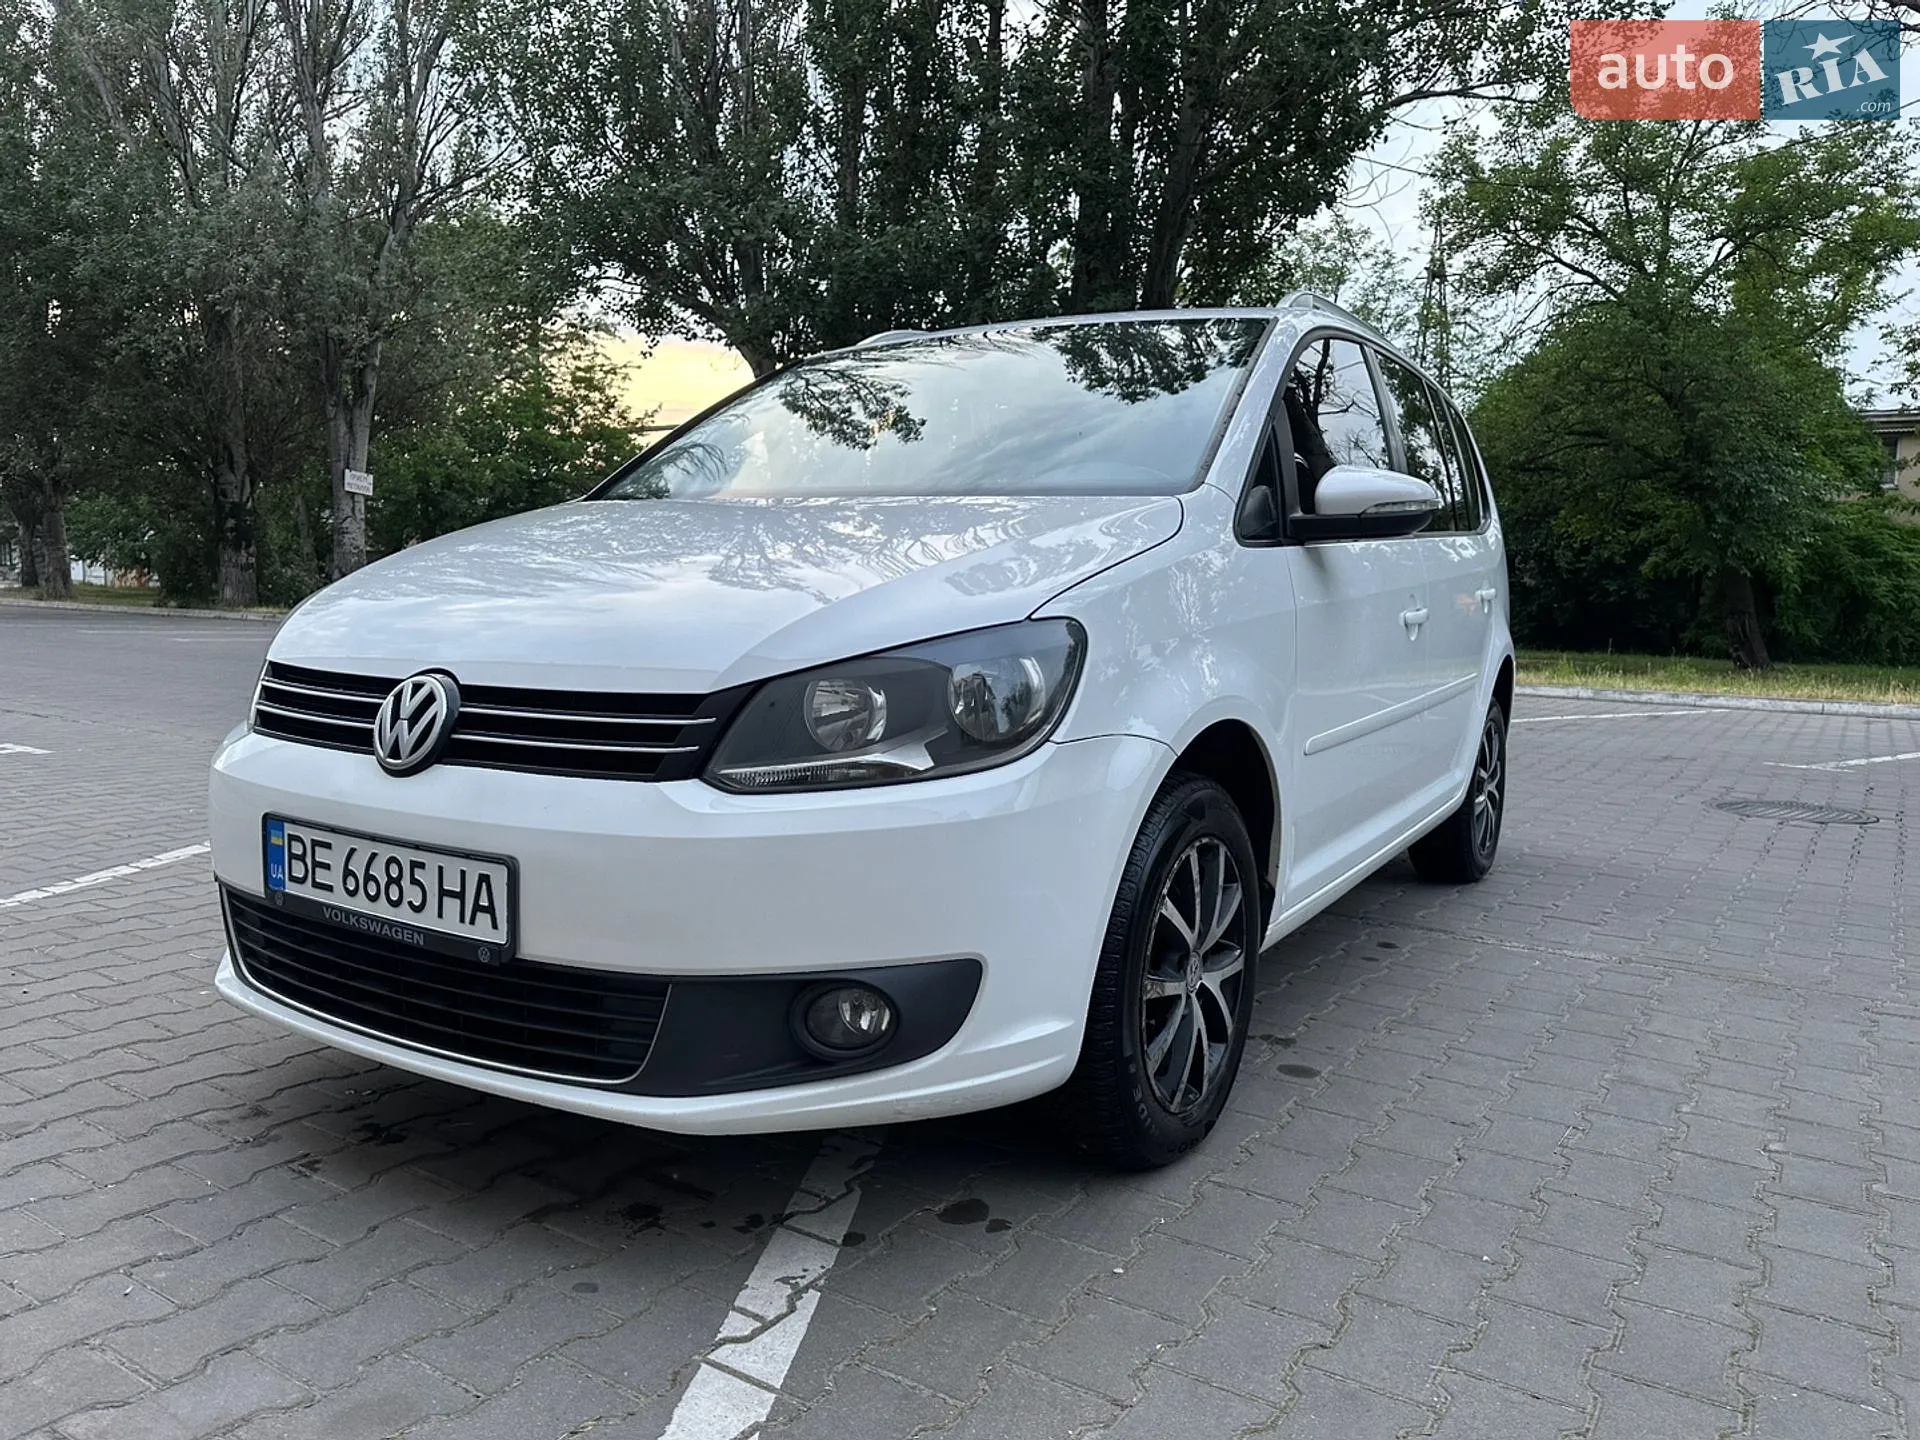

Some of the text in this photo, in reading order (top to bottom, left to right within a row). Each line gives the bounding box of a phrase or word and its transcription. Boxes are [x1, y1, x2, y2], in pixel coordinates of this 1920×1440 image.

[270, 864, 284, 880] UA
[287, 833, 499, 930] BE 6685 HA
[323, 907, 424, 946] VOLKSWAGEN
